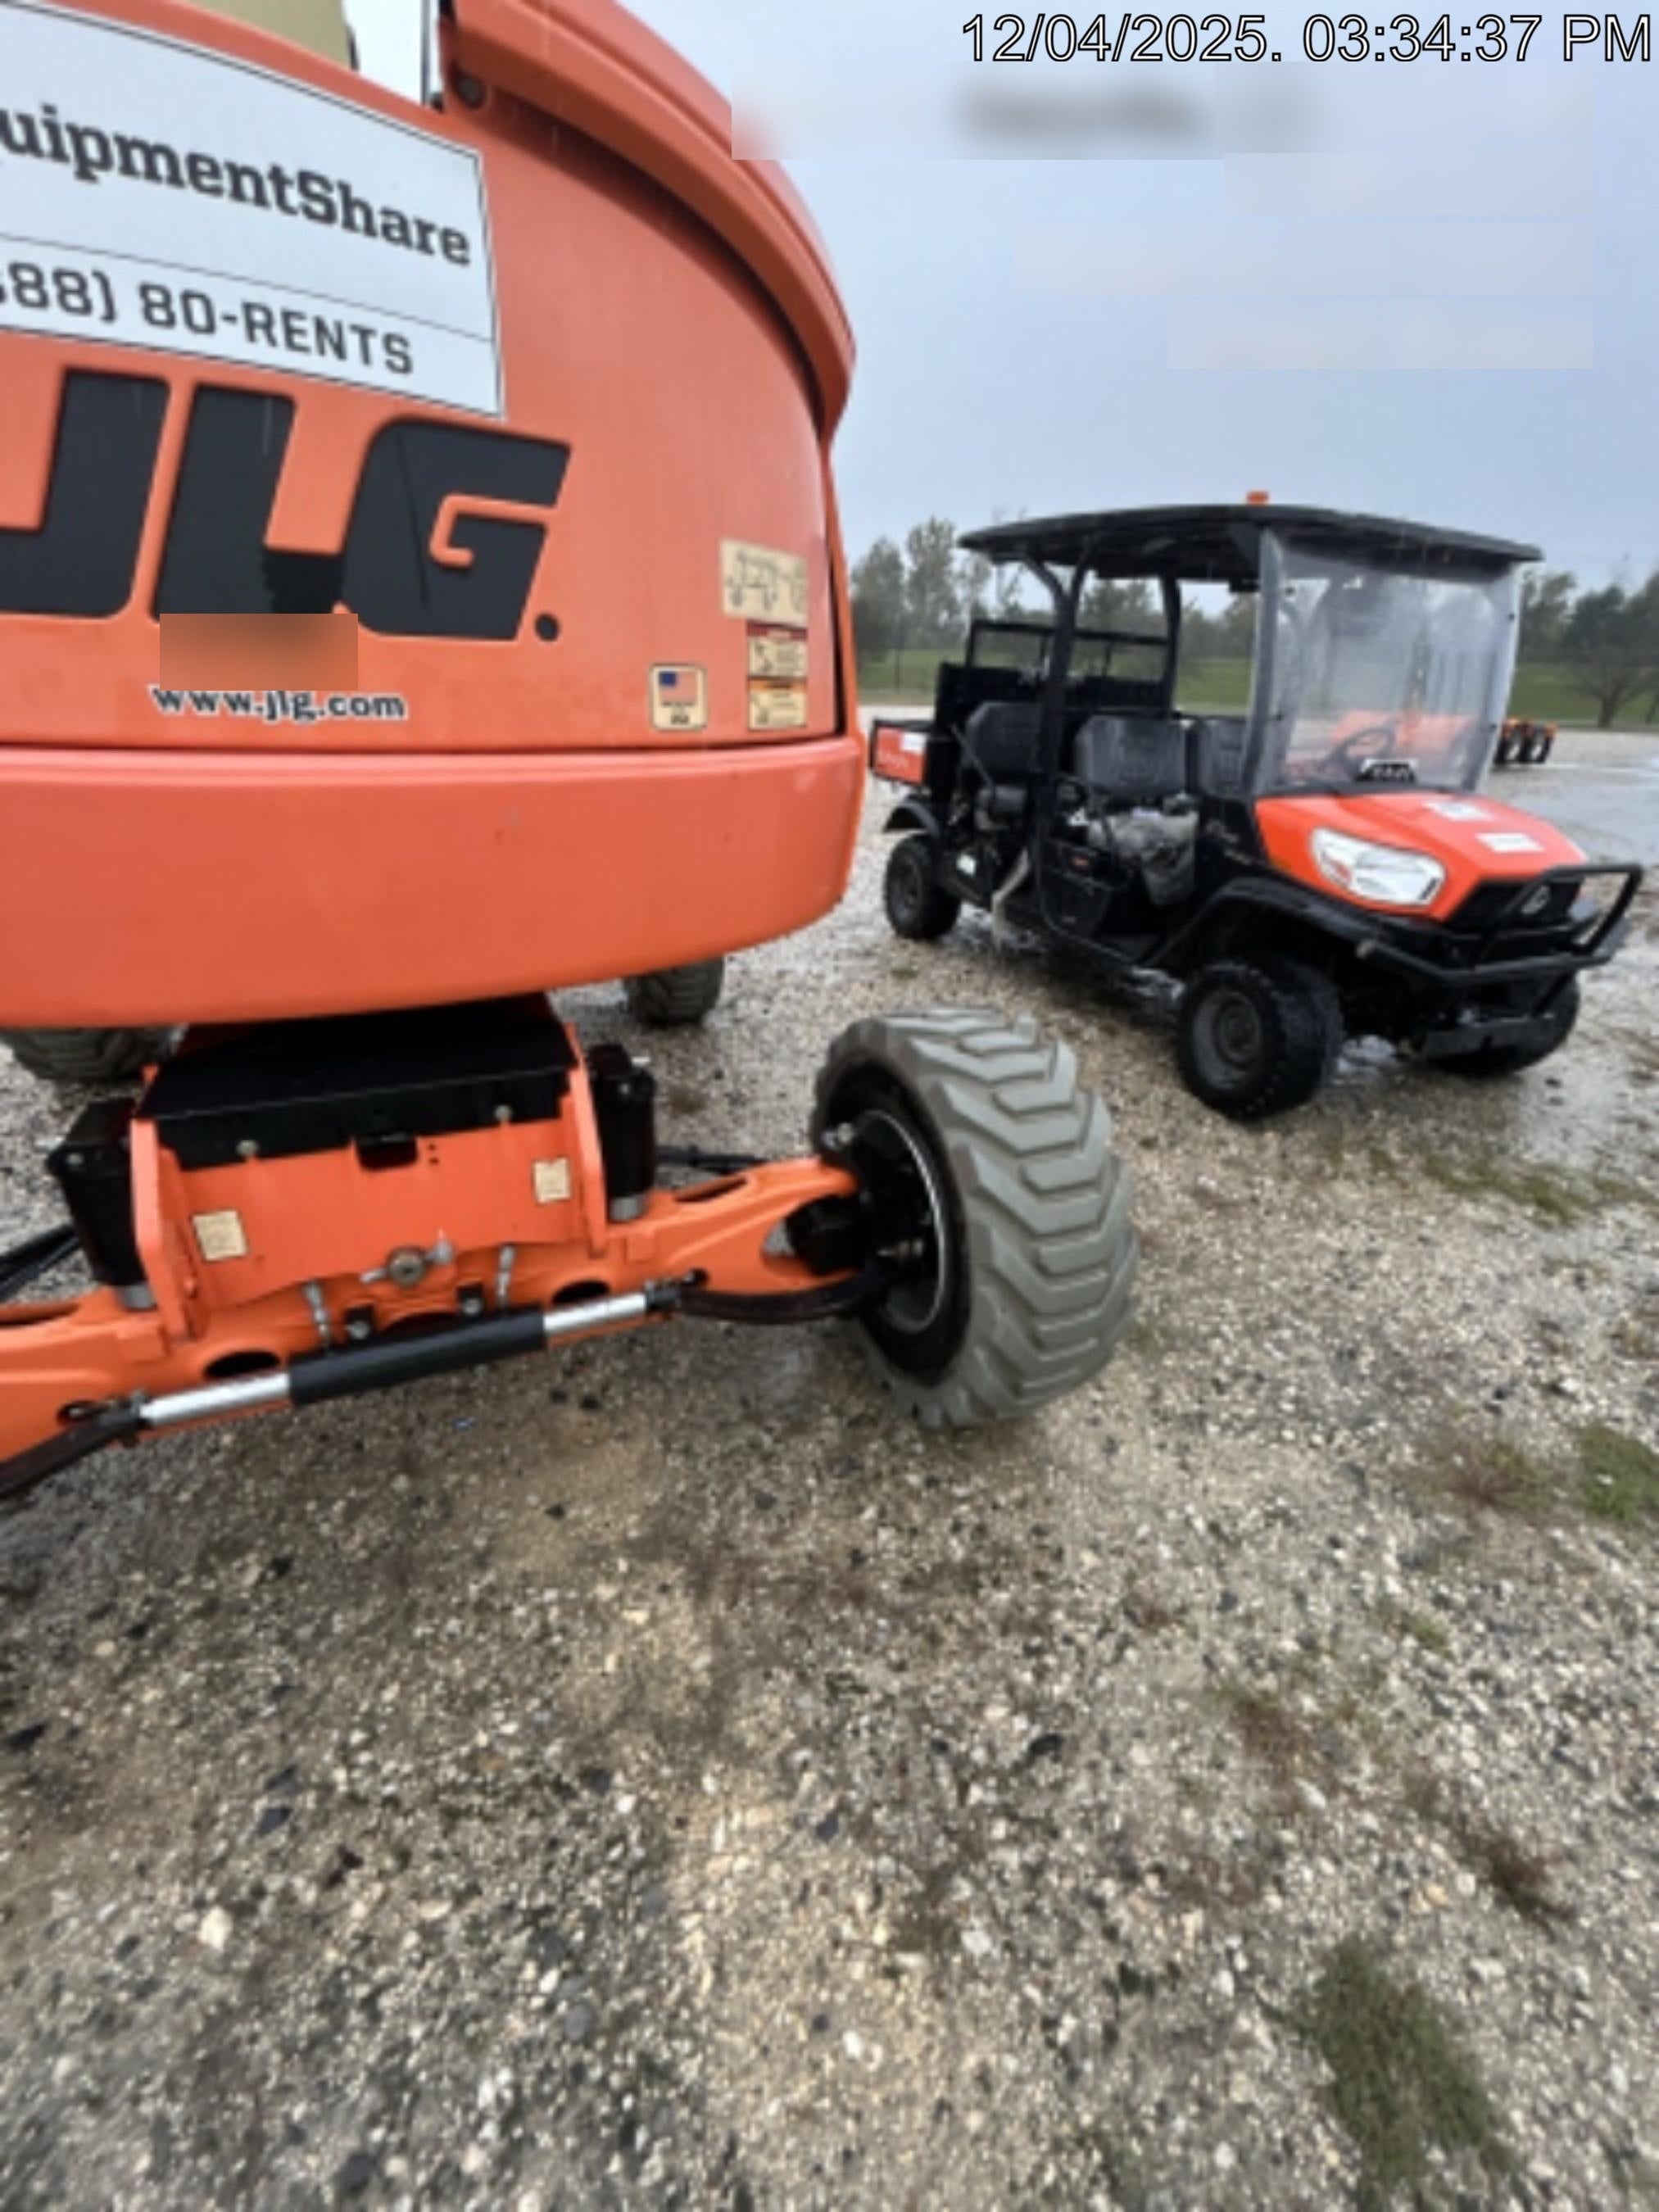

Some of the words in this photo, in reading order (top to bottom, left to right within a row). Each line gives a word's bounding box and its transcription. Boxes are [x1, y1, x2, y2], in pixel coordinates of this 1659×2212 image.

[0, 103, 471, 266] uipmentShare
[0, 261, 116, 323] 88)
[138, 282, 415, 375] 80-RENTS
[149, 687, 407, 722] www.jlg.com
